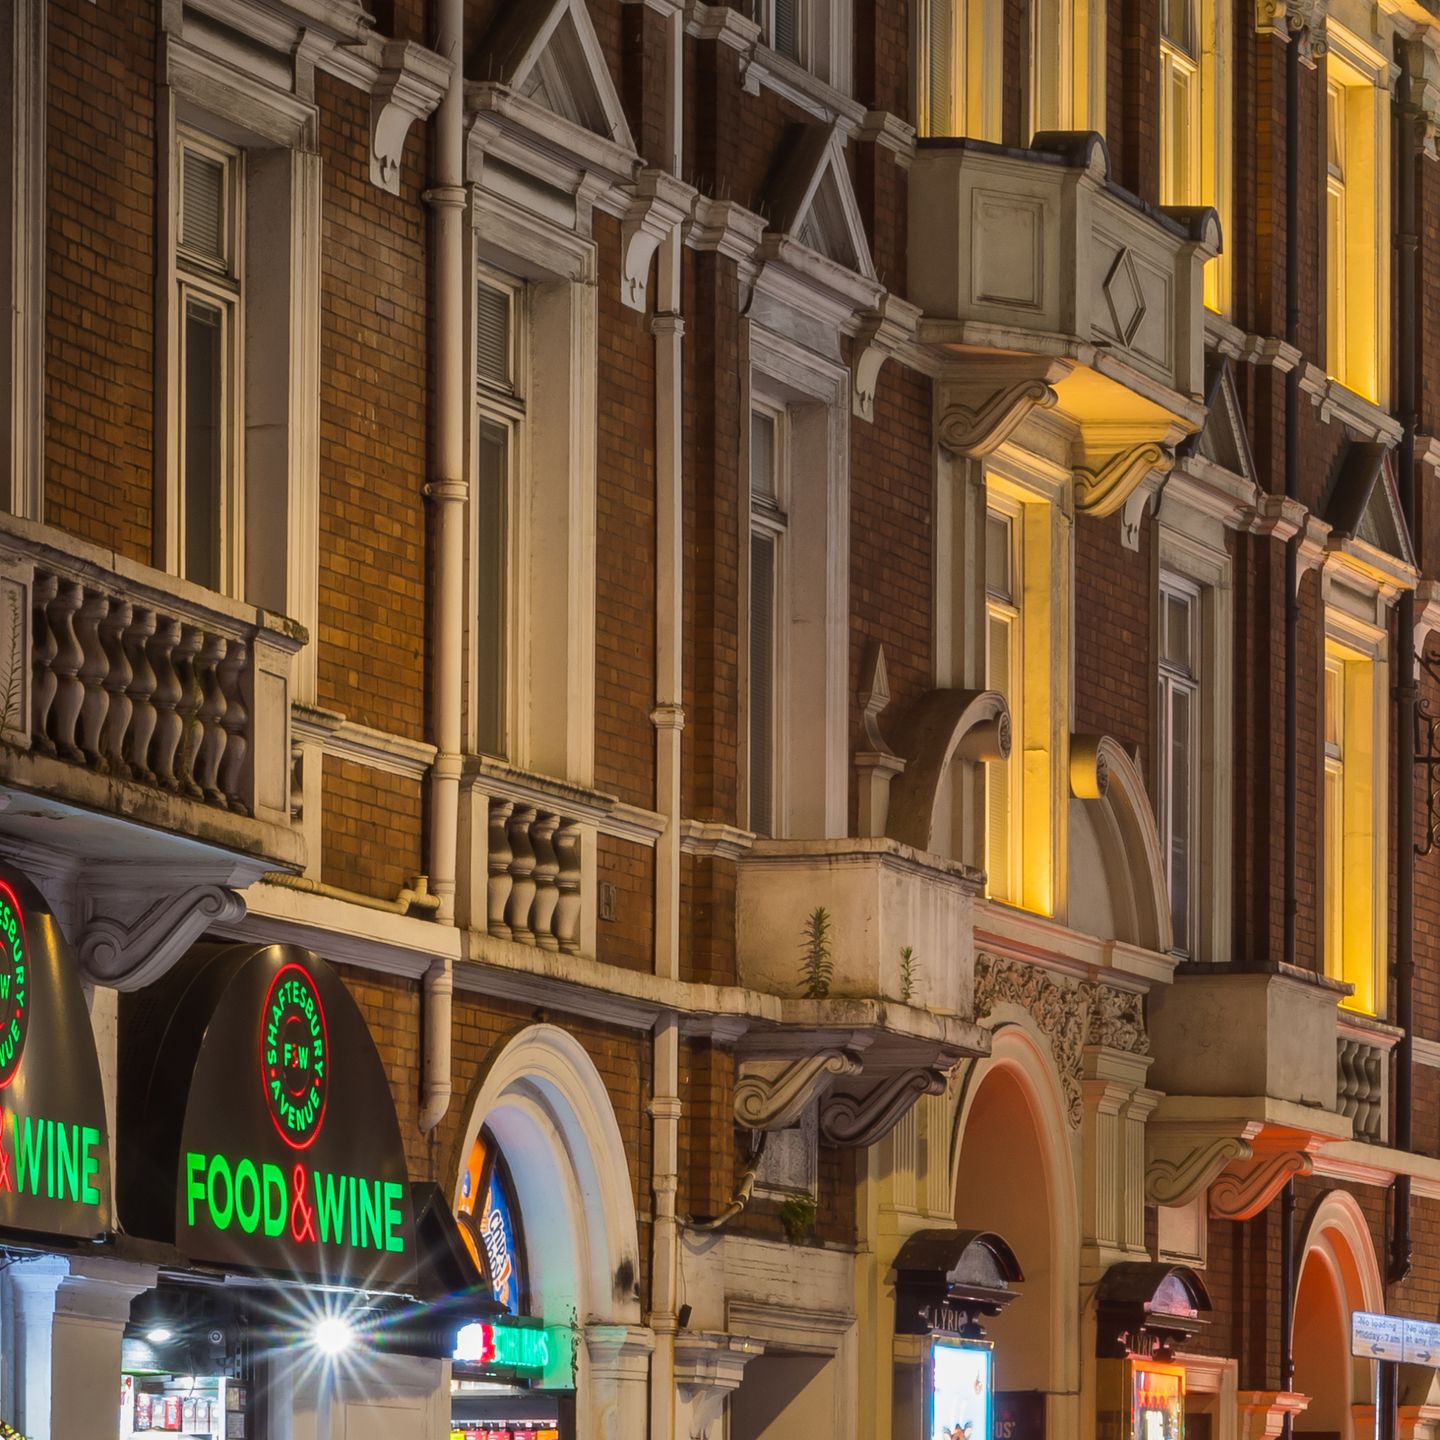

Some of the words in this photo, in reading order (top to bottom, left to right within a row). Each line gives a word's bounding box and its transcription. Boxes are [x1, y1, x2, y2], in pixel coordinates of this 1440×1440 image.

[266, 980, 323, 1079] SHAFTESBURY
[270, 1079, 320, 1132] AVENUE
[1414, 1337, 1428, 1347] any
